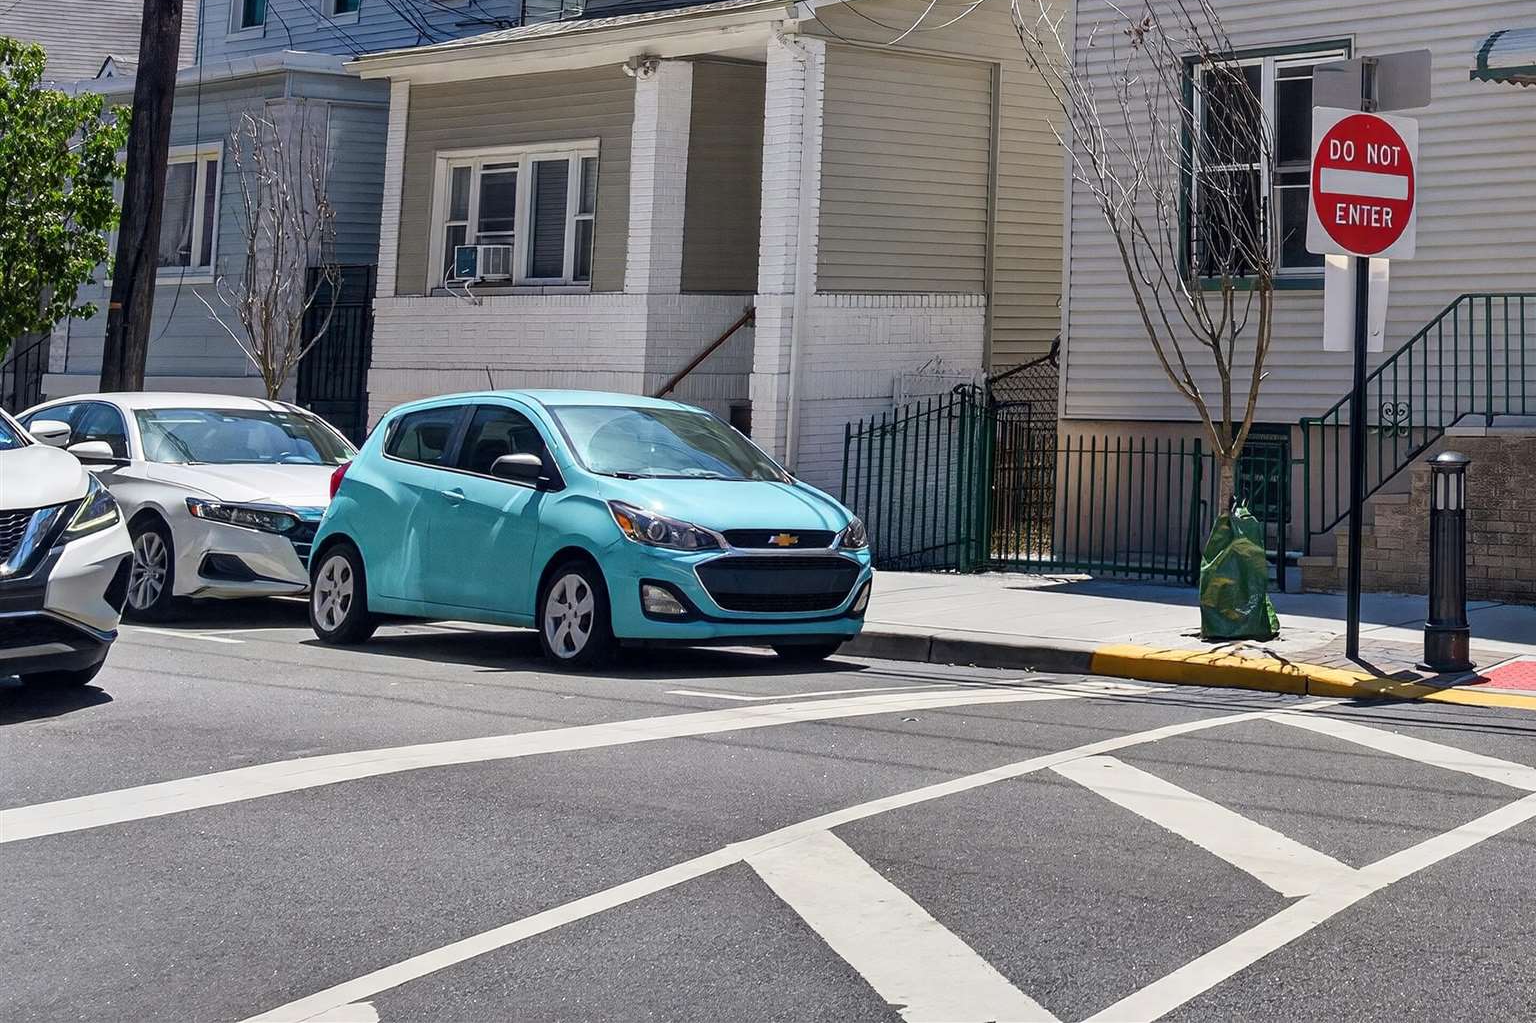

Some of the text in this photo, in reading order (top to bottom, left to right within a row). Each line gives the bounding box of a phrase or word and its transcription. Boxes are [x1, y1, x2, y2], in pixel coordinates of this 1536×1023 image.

[1330, 139, 1400, 166] DO NOT
[1335, 203, 1392, 228] ENTER
